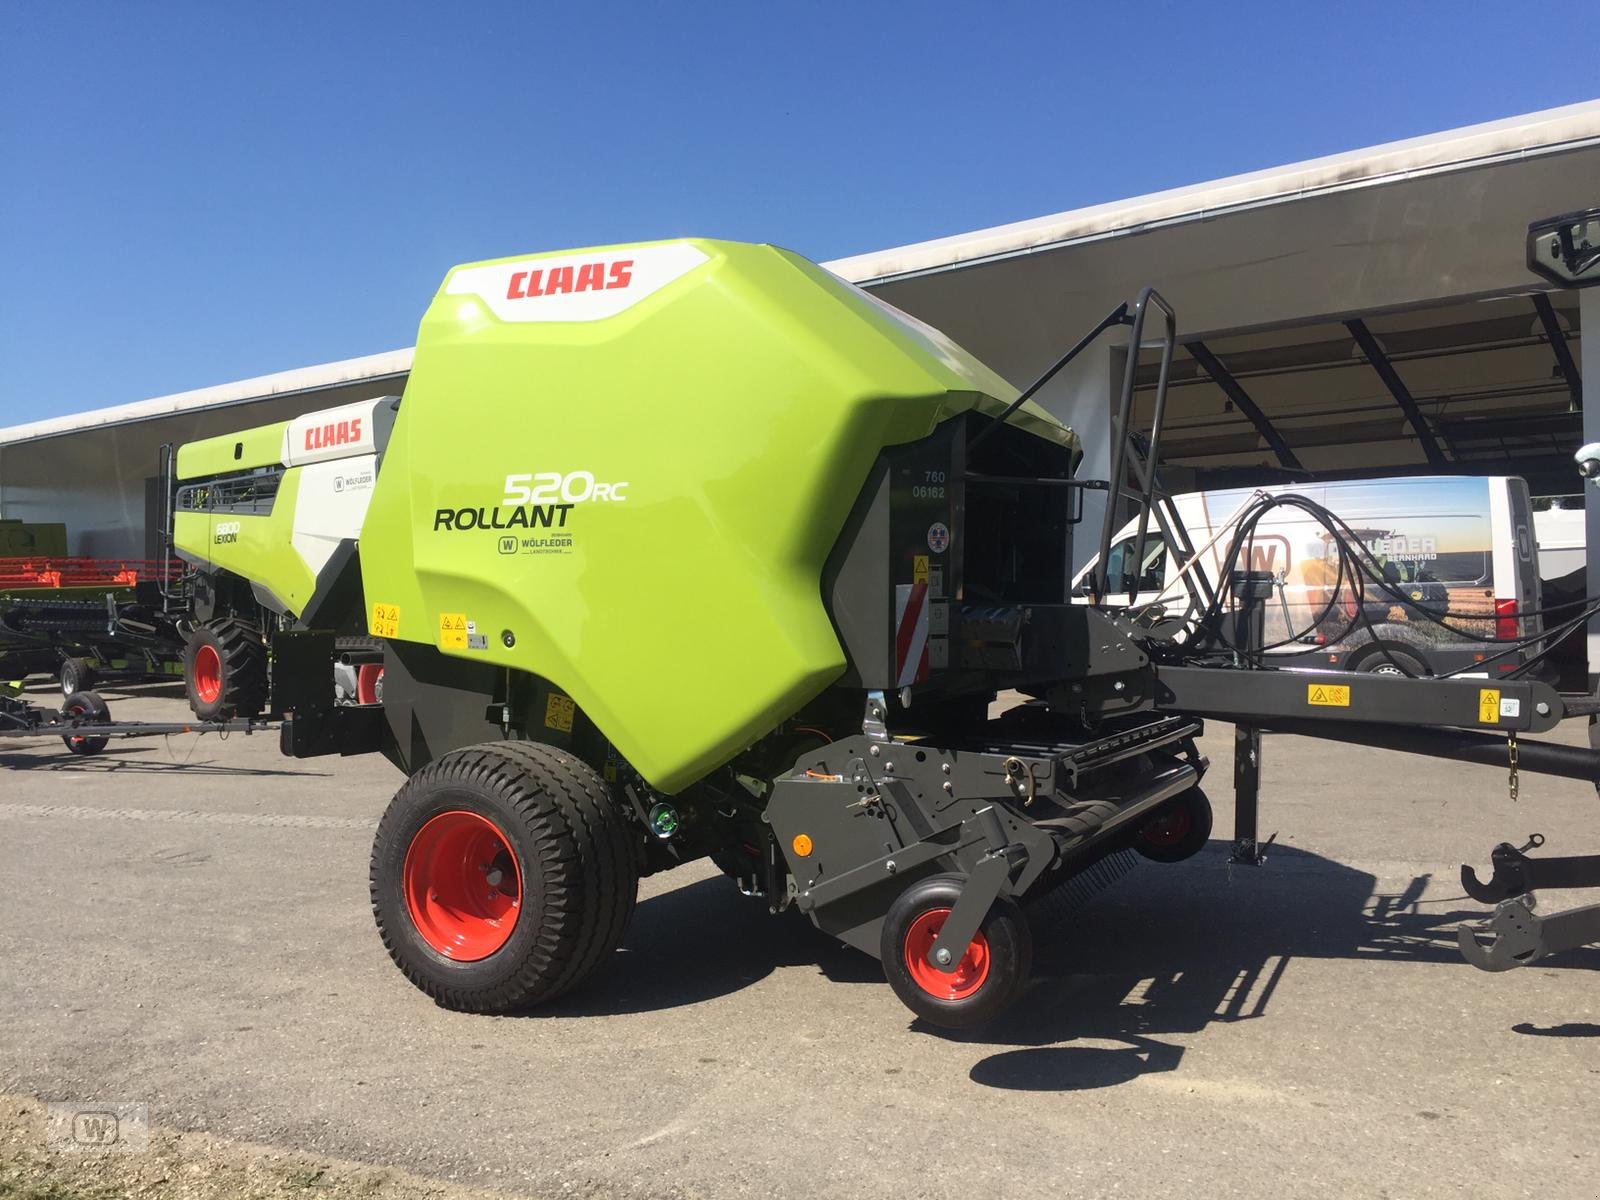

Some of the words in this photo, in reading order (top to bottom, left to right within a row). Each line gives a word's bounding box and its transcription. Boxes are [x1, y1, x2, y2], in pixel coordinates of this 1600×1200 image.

[506, 260, 634, 300] CLAAS
[305, 418, 361, 450] CLAAS
[925, 471, 945, 483] 760
[912, 486, 945, 499] 06162
[433, 503, 575, 532] ROLLANT
[214, 532, 237, 545] LEXION
[521, 537, 573, 548] WÖLFLEDER
